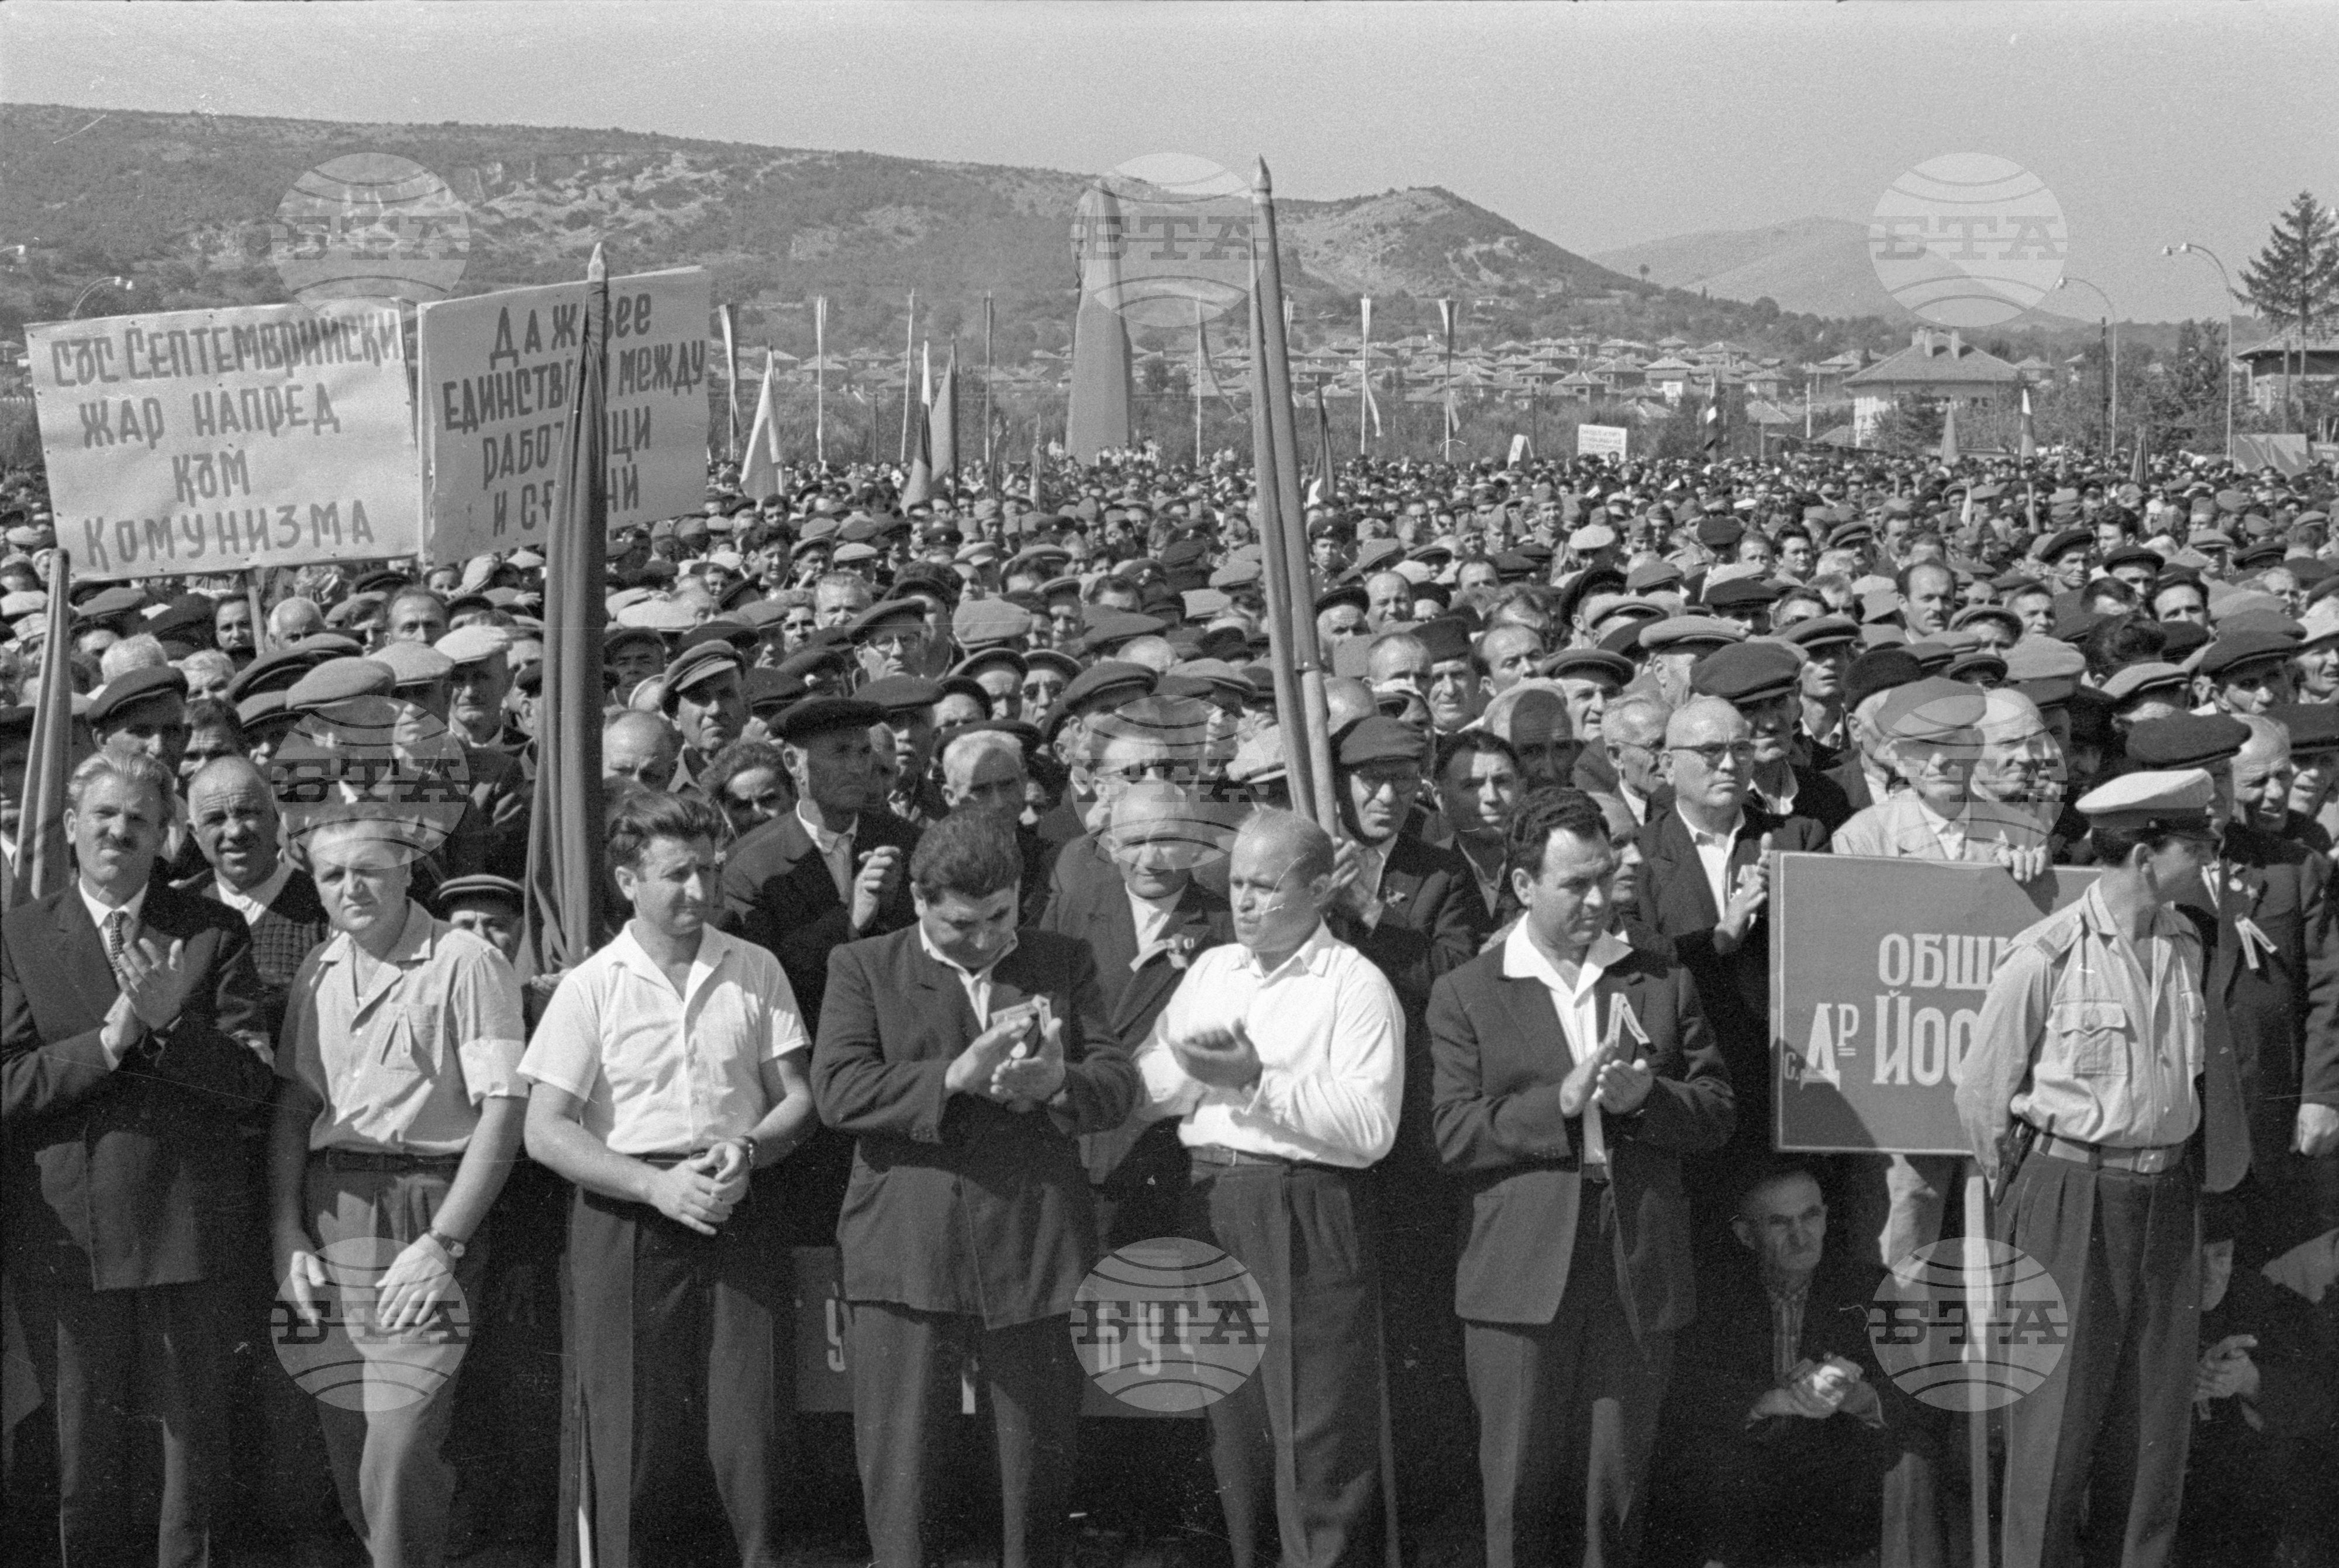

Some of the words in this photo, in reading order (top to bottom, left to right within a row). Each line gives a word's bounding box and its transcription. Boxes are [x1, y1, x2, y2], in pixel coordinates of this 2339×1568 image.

[51, 336, 120, 387] СЪС
[79, 397, 165, 450] ЖАР
[192, 382, 341, 437] НАПРЕД
[173, 450, 250, 508] КЪМ
[84, 500, 375, 572] КОМУНИЗМА
[493, 490, 508, 537] И
